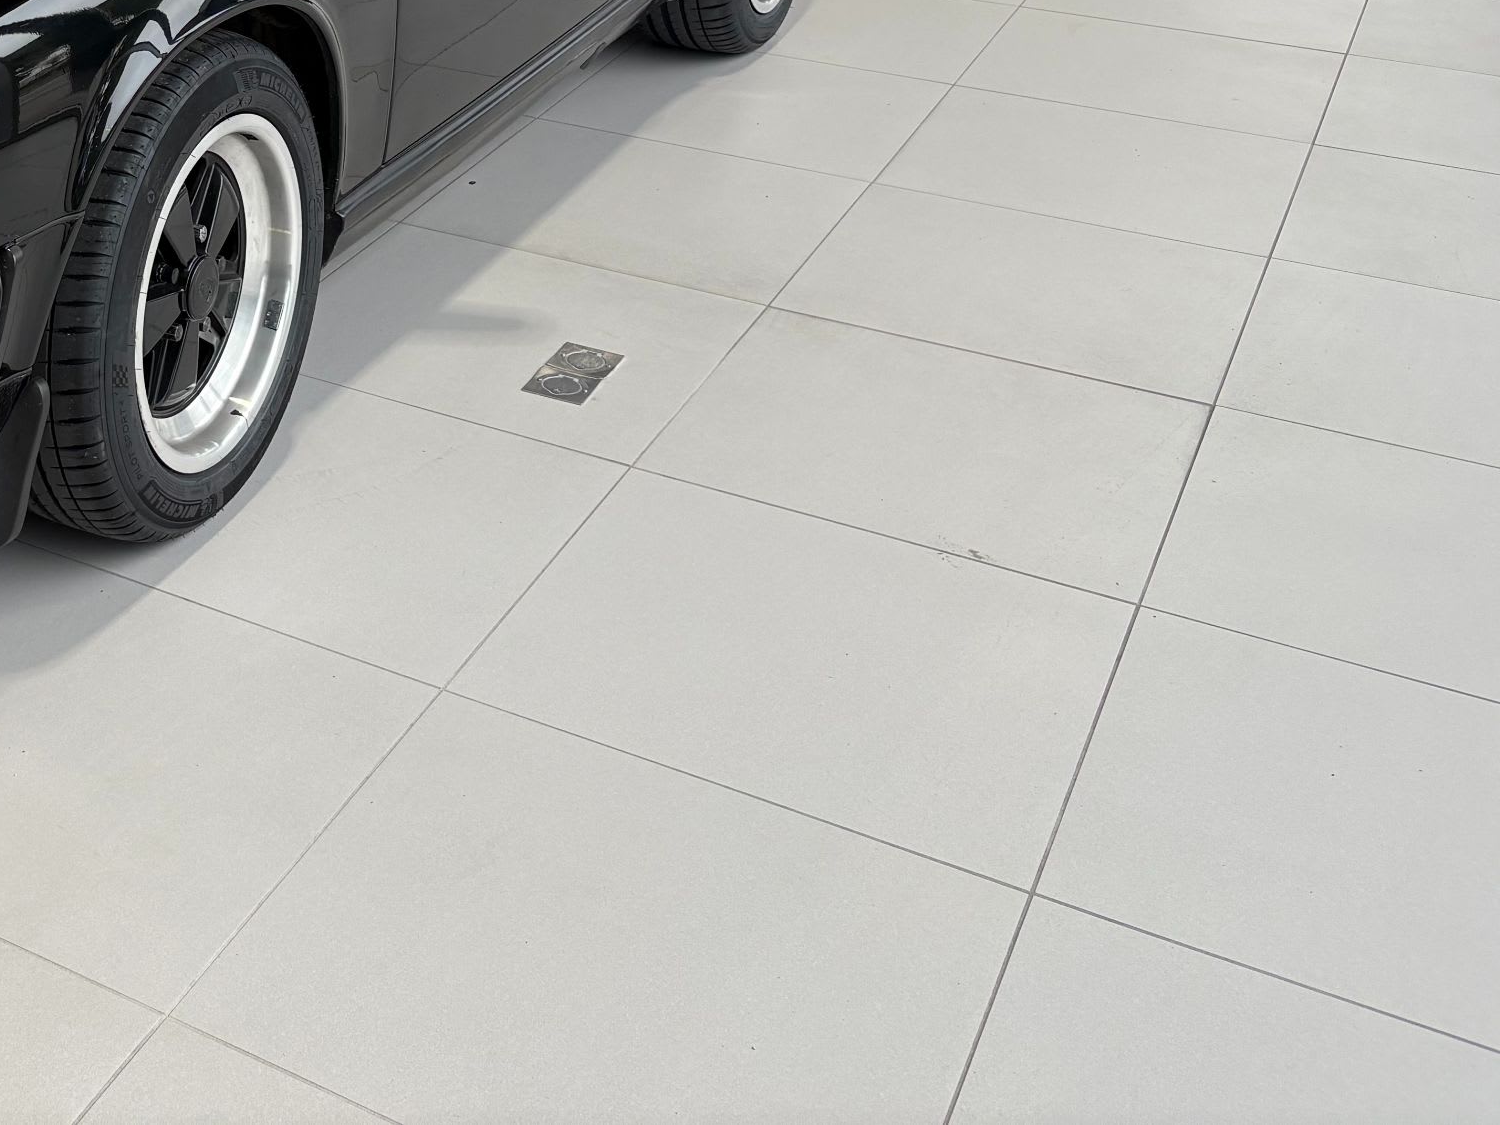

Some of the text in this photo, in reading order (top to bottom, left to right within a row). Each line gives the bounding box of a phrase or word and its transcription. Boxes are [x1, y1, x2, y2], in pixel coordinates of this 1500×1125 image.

[260, 71, 308, 121] MICHELIN
[120, 409, 134, 449] SPORT
[127, 453, 144, 481] PILOT
[143, 486, 201, 520] MICHELIN
